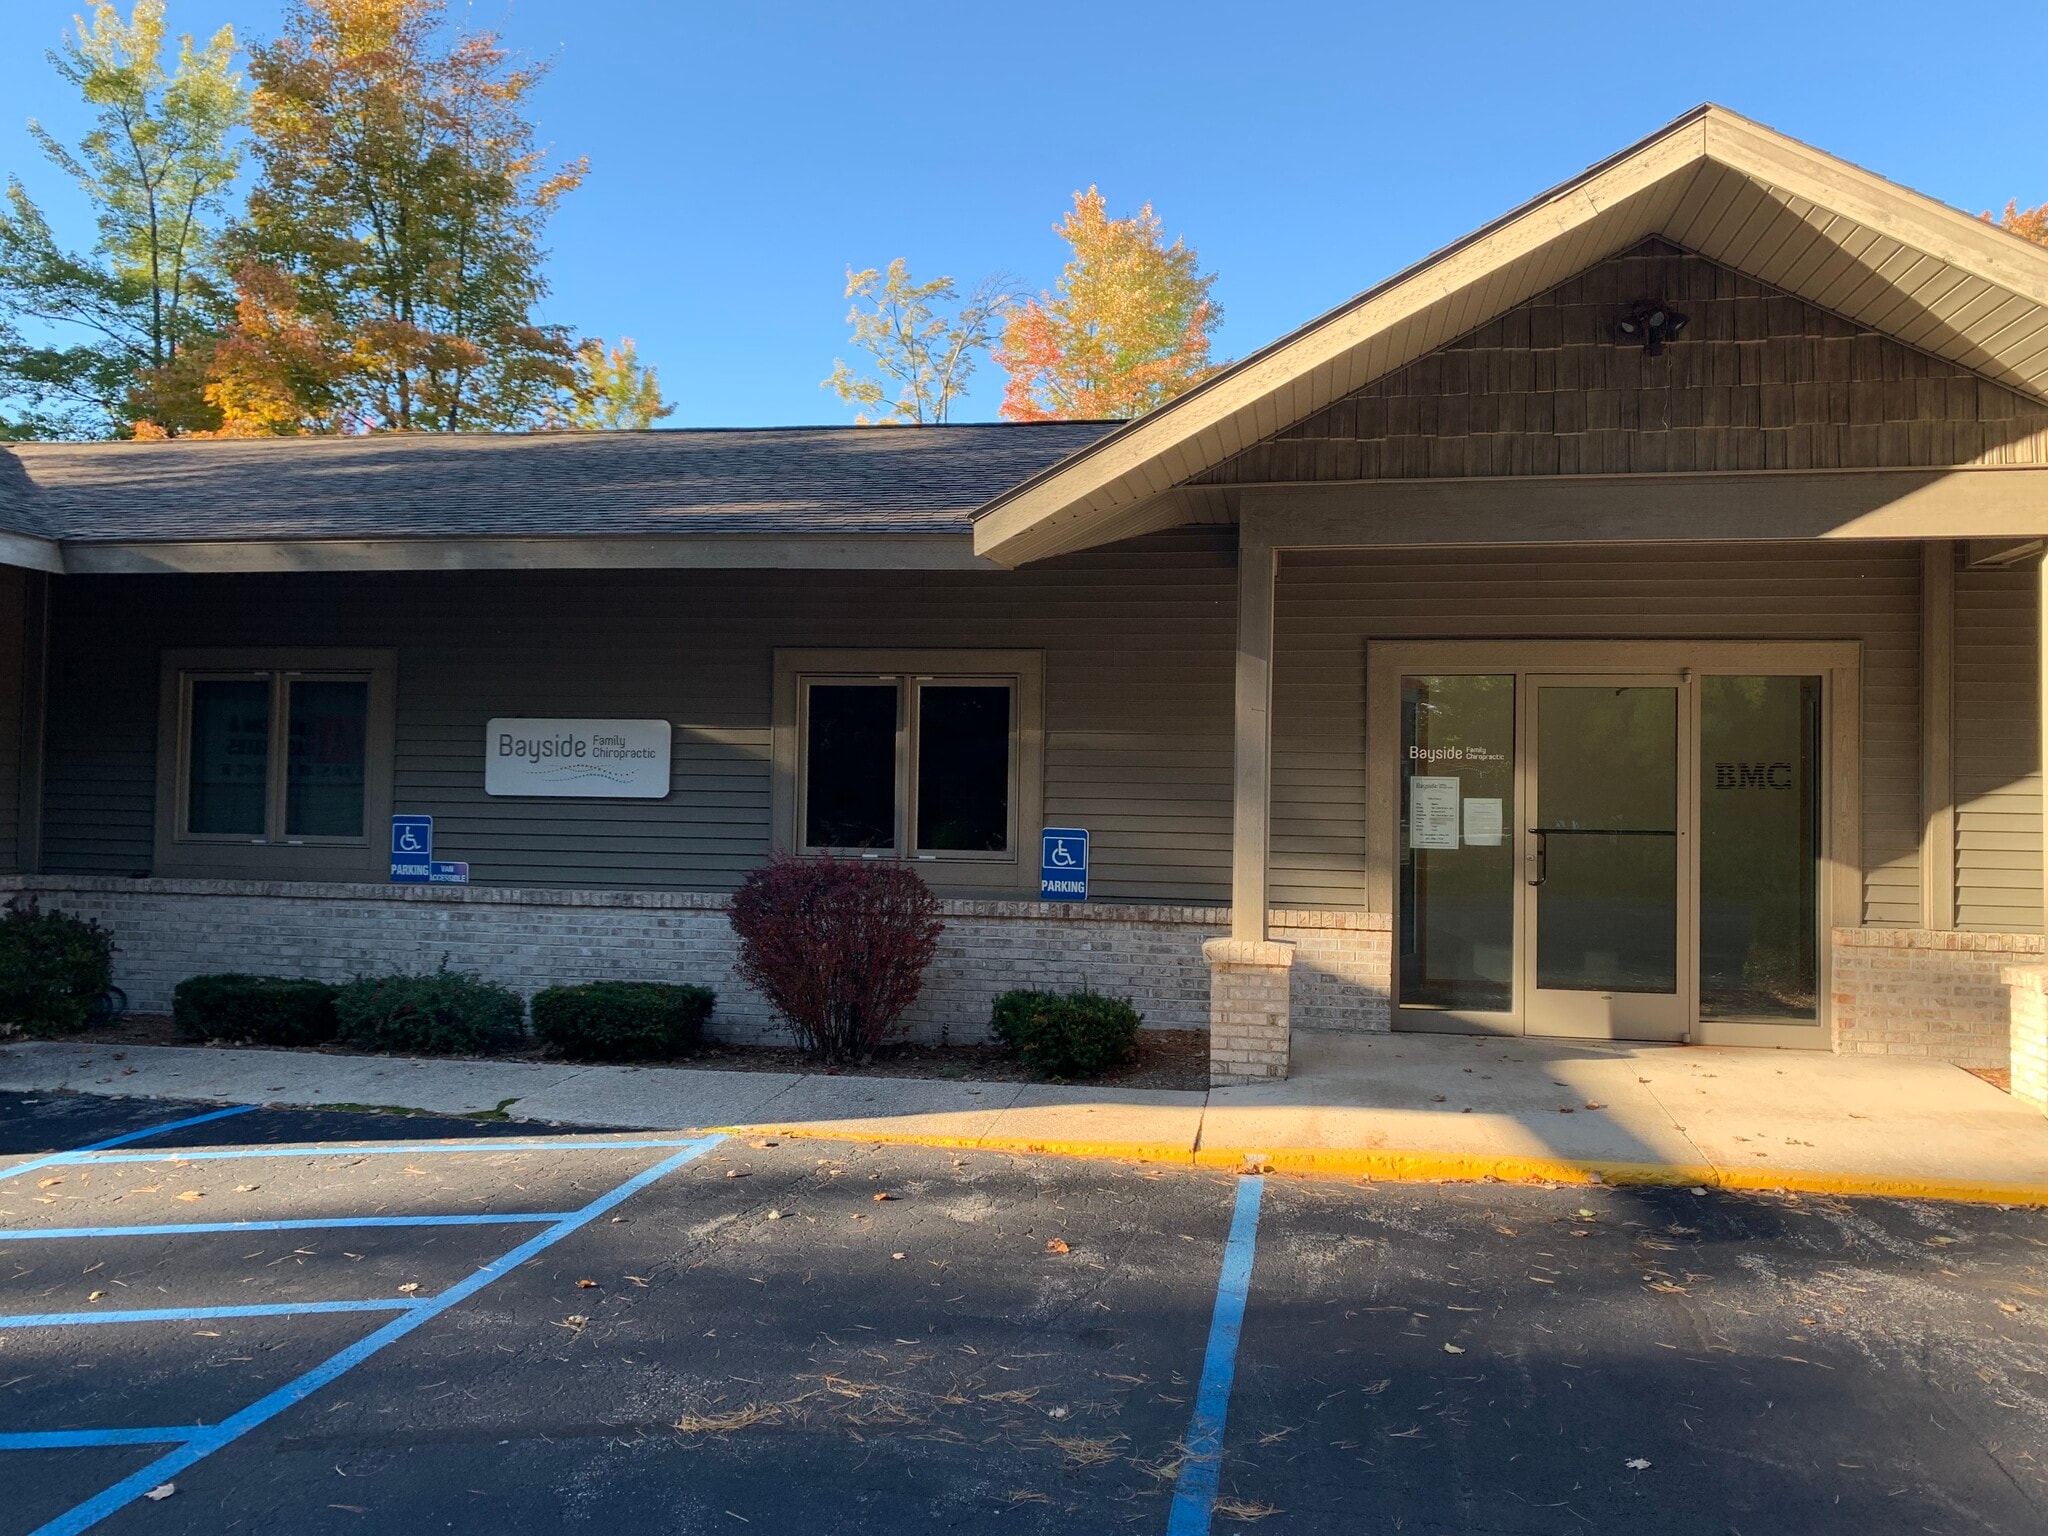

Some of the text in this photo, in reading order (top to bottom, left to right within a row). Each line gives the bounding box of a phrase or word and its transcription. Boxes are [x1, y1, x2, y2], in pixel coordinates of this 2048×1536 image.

[499, 733, 587, 763] Bayside
[592, 735, 626, 748] Family
[592, 747, 656, 760] Chiropractic
[1409, 745, 1463, 763] Bayside
[1466, 746, 1487, 755] Family
[1466, 753, 1505, 761] Chiropractic
[1714, 762, 1792, 790] BMC
[391, 864, 429, 876] PARKING
[440, 865, 454, 873] VAN
[1041, 880, 1085, 893] PARKING
